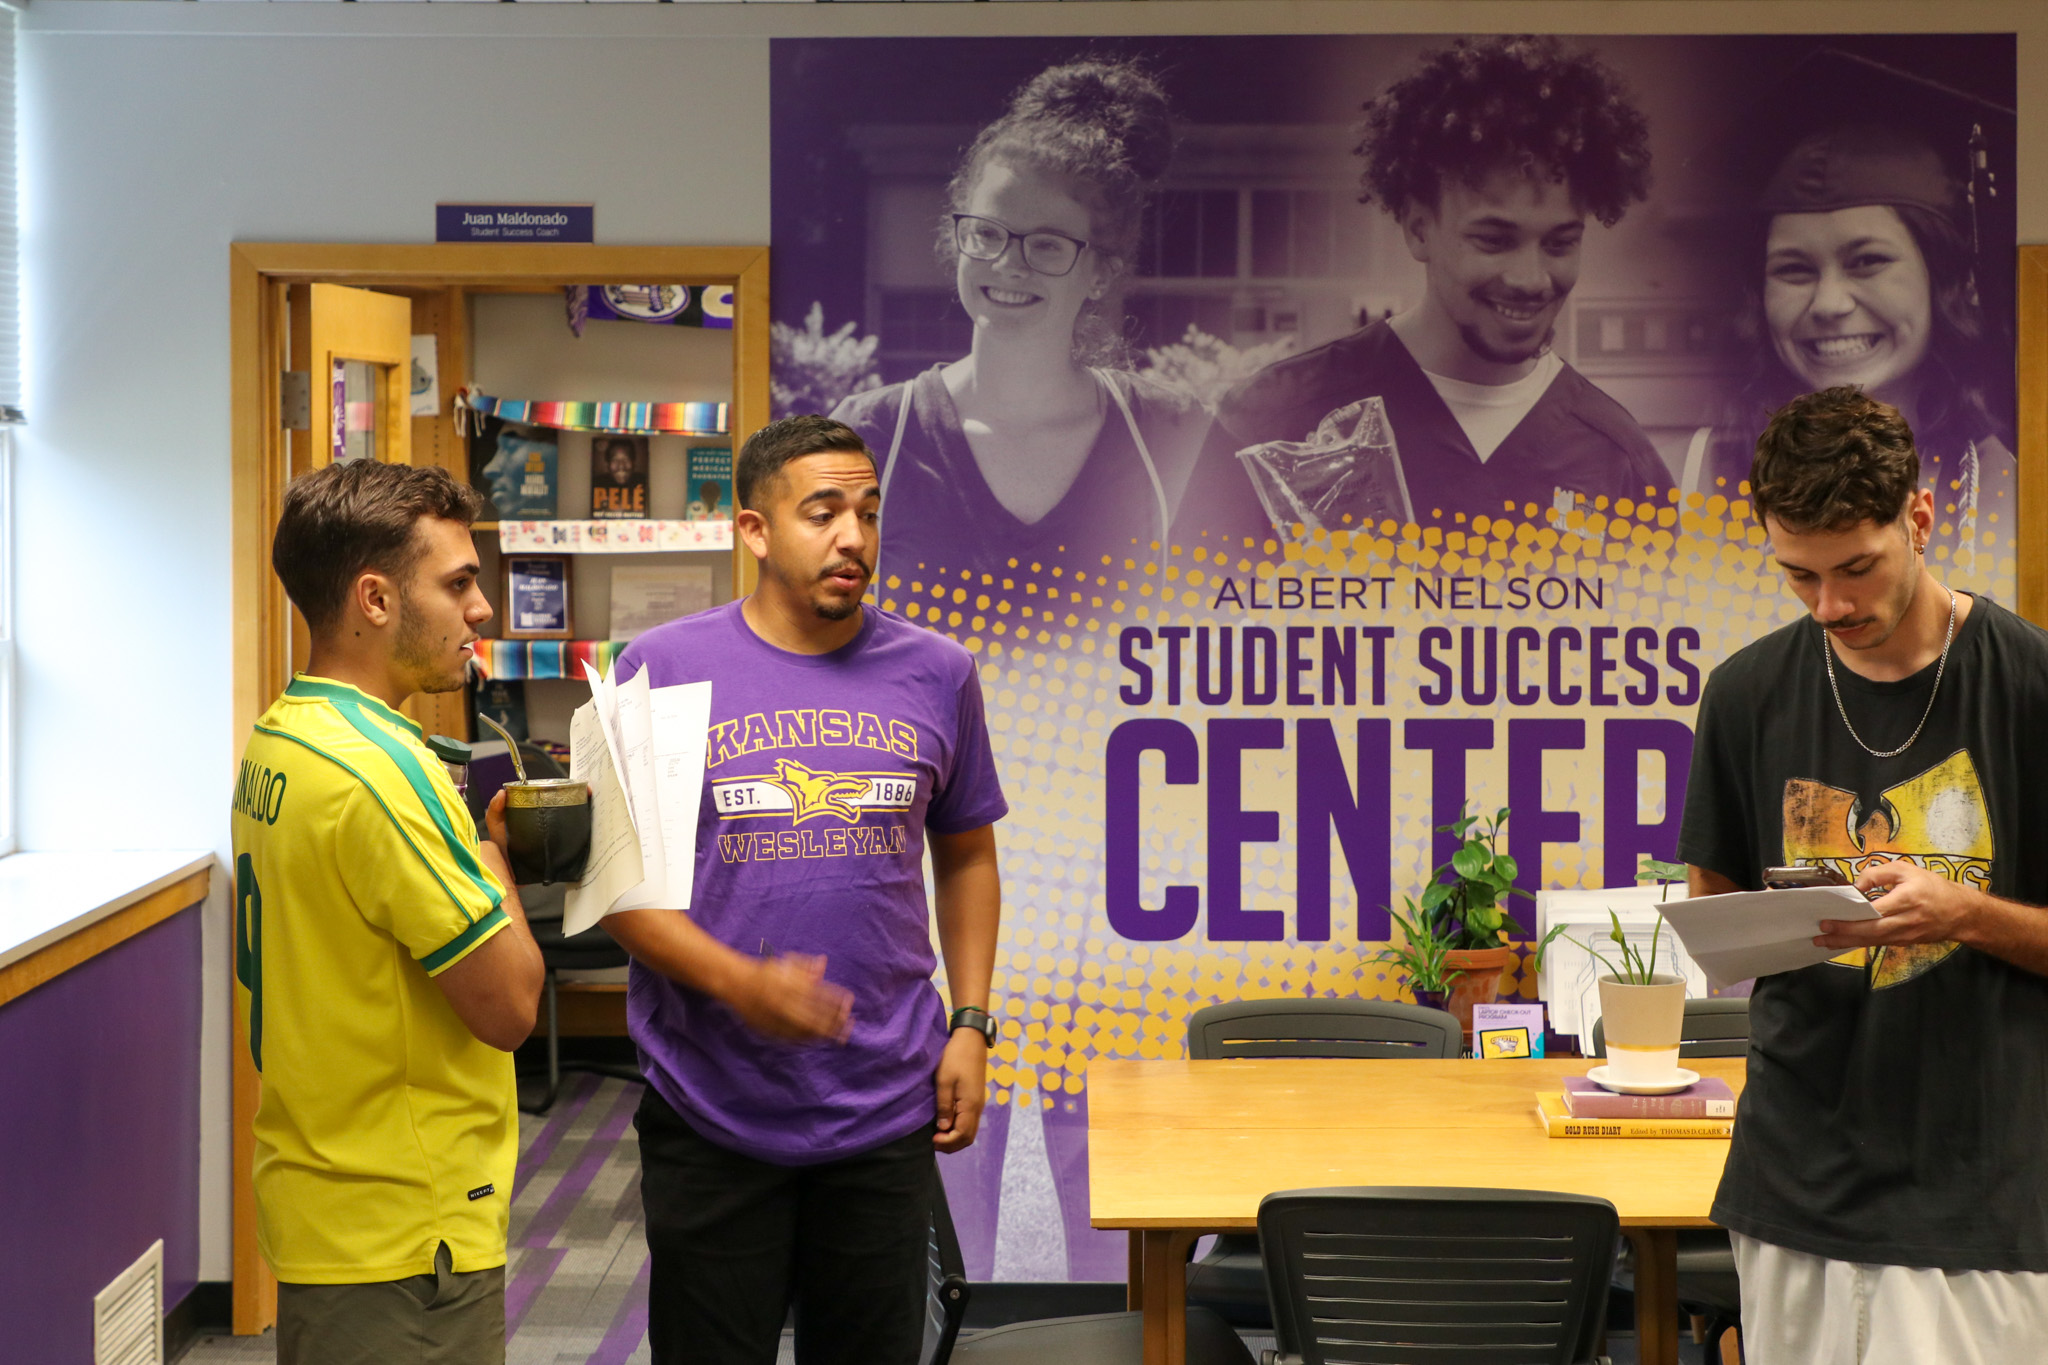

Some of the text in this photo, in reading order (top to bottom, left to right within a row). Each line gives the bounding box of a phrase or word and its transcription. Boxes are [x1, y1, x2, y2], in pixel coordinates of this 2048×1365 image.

[462, 211, 568, 226] Juan Maldonado
[471, 227, 560, 237] Student Success Coach
[593, 483, 645, 510] PELÉ
[1214, 577, 1604, 610] ALBERT NELSON
[1119, 626, 1701, 706] STUDENT SUCCESS
[707, 709, 919, 769] KANSAS
[723, 781, 913, 807] EST. 1886
[717, 825, 907, 864] WESLEYAN
[1565, 1126, 1582, 1135] GOLD
[1583, 1126, 1600, 1135] RUSH
[1601, 1126, 1621, 1135] DIARY
[1650, 1128, 1657, 1136] by
